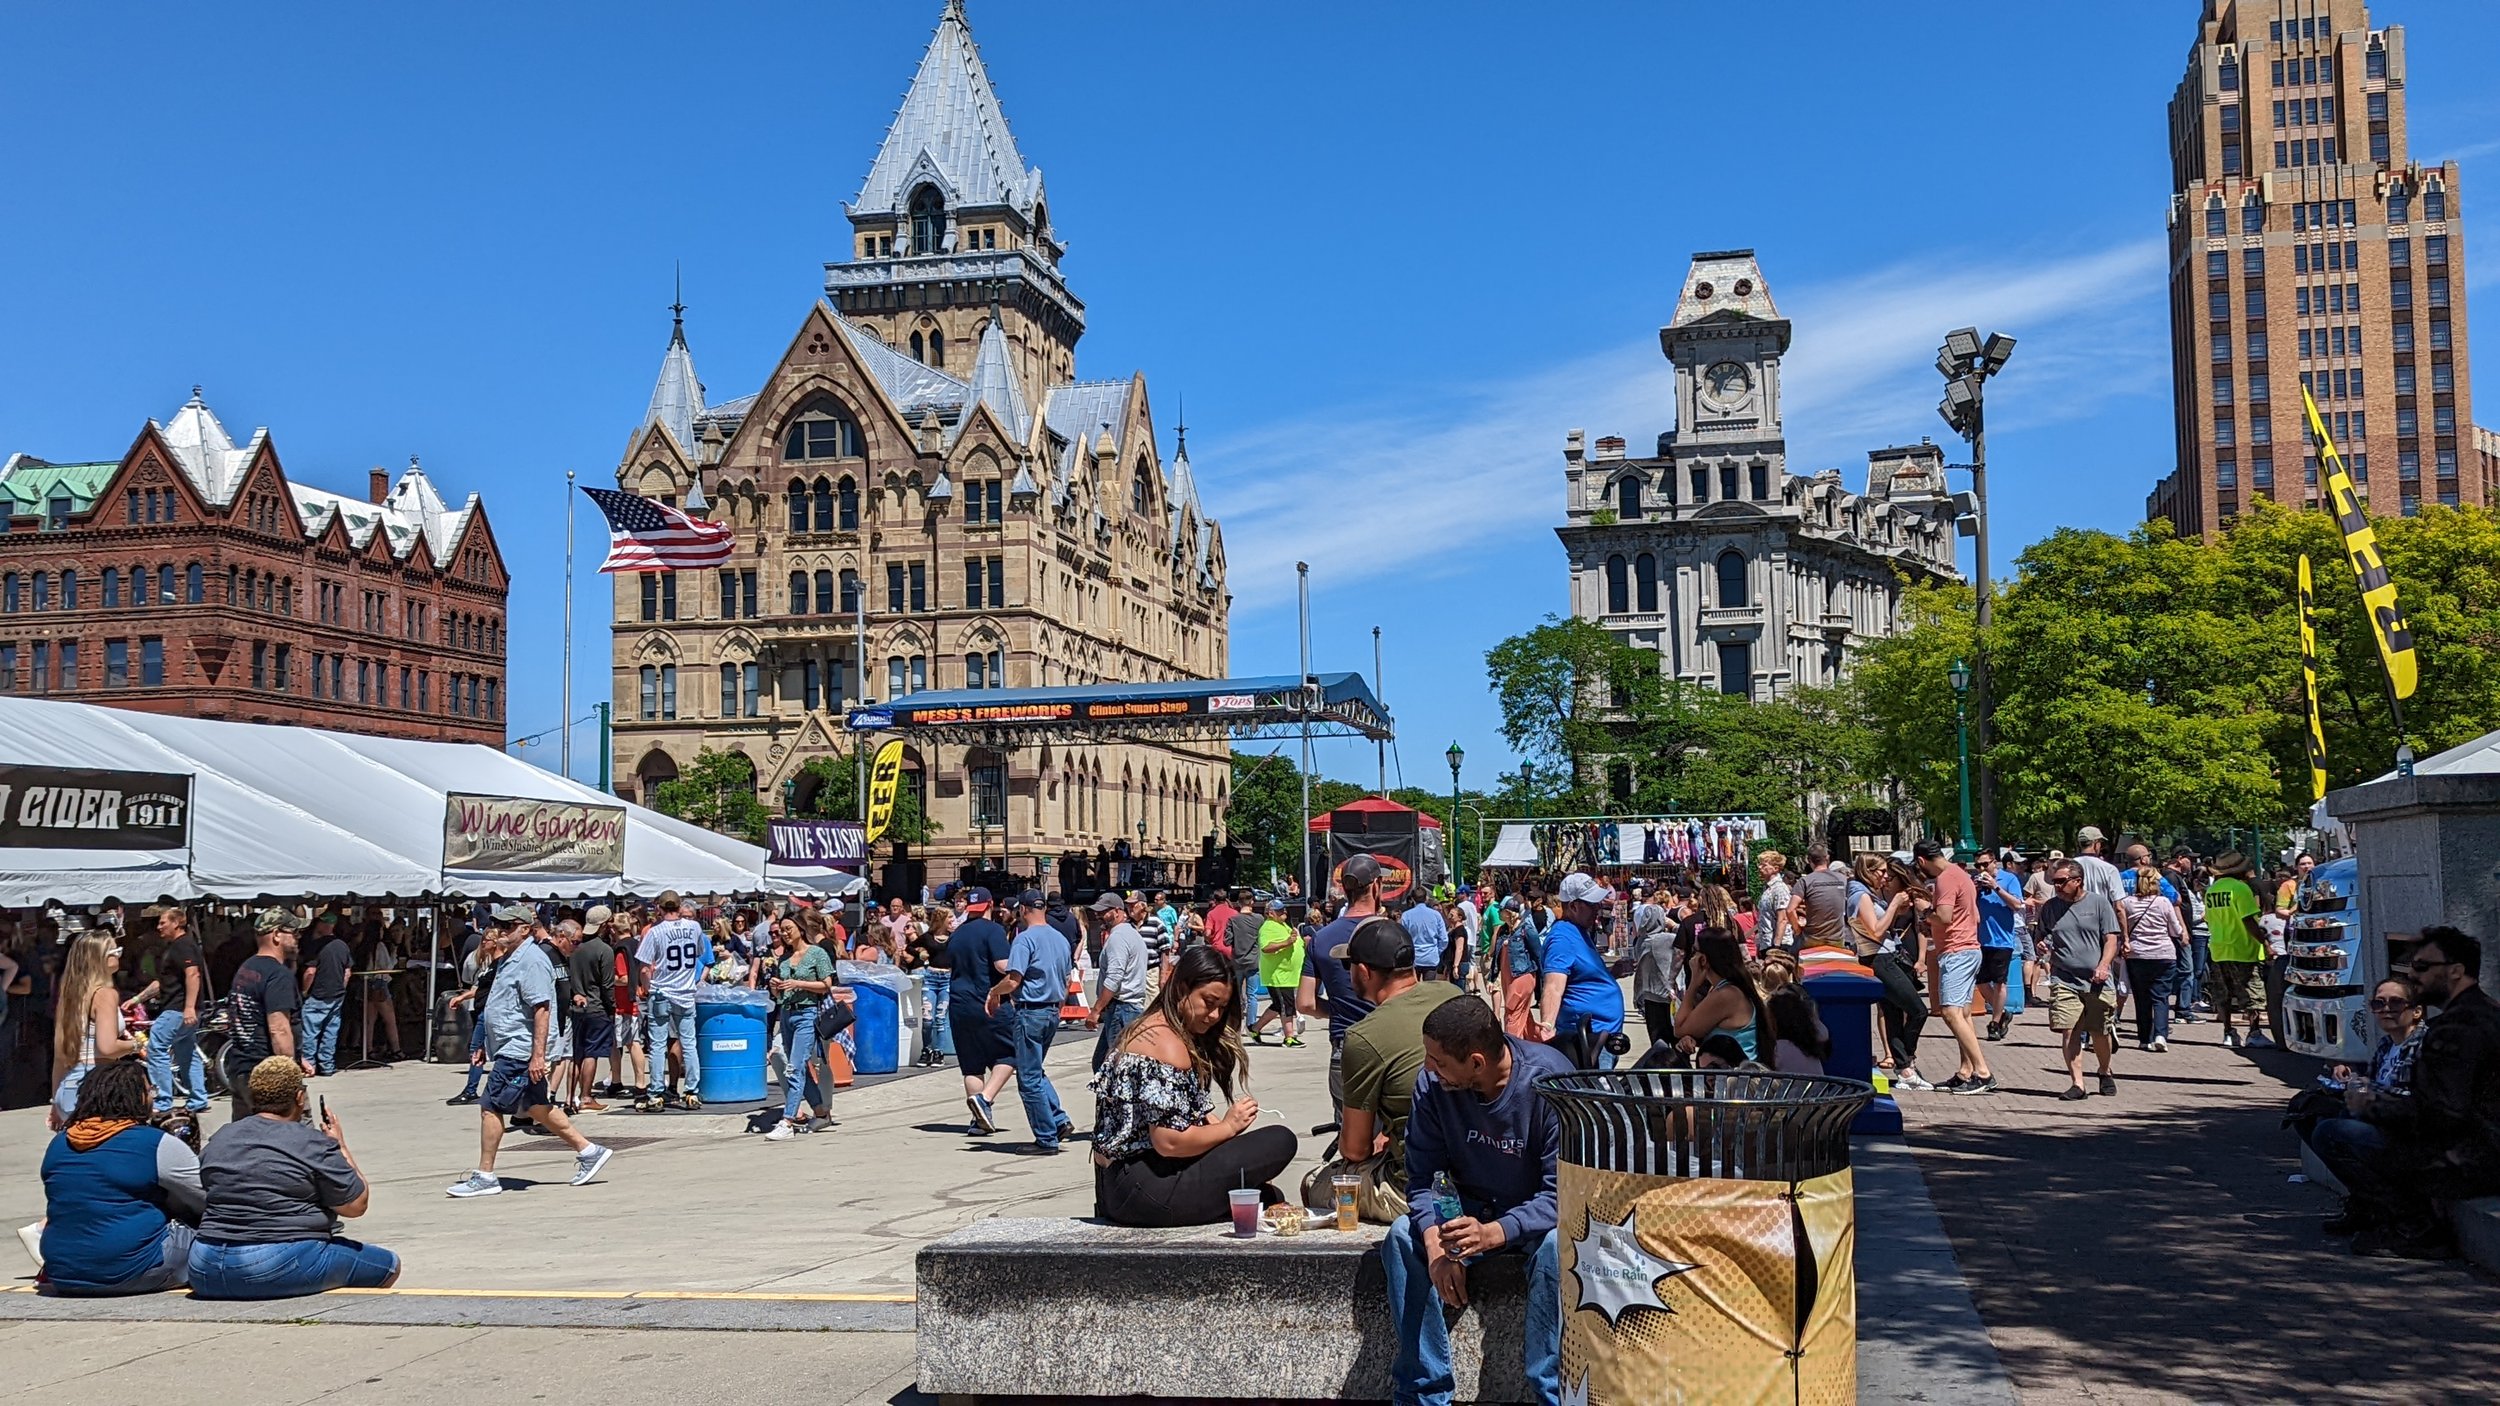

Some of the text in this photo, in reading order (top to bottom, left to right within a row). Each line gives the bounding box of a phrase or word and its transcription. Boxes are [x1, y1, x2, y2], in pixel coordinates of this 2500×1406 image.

[913, 708, 972, 722] MESS'S
[975, 704, 1072, 719] FIREWORKS
[1089, 701, 1188, 716] Clinton Square Stage
[871, 760, 898, 829] EER
[17, 786, 122, 830] CIDER
[126, 804, 181, 827] 1911
[460, 799, 622, 842] Wine Garden
[481, 838, 507, 851] Wine
[508, 838, 543, 854] Slushies
[551, 841, 575, 854] Select
[576, 842, 605, 855] Wines
[772, 825, 866, 859] WINE SLUSHY
[2206, 891, 2231, 908] STAFF
[666, 928, 694, 944] JUDGE
[667, 943, 697, 971] 99
[1581, 1260, 1648, 1282] Save the Rain
